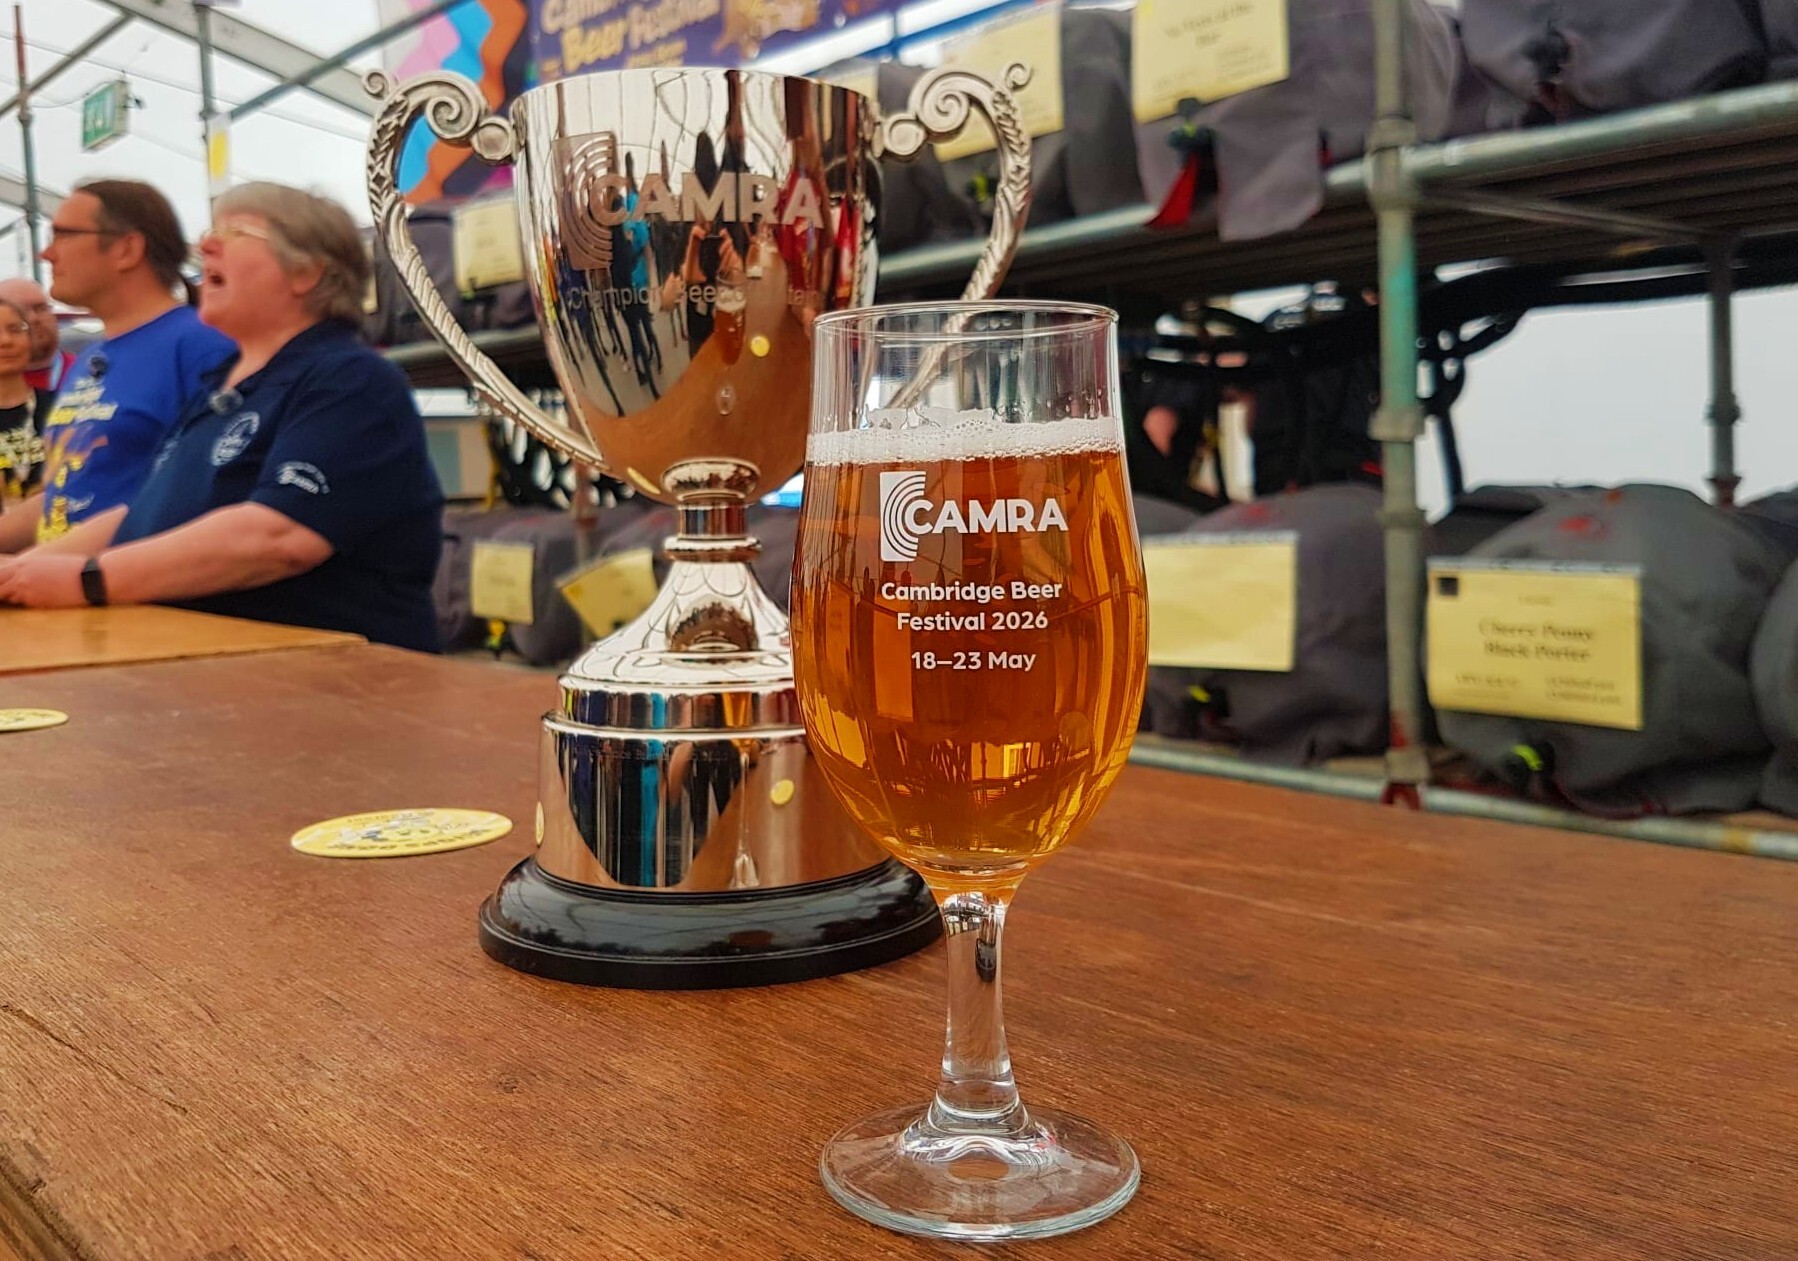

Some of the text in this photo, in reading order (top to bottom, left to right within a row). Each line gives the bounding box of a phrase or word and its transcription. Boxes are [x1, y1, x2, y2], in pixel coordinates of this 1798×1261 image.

[589, 171, 824, 229] CAMRA
[904, 498, 1069, 535] CAMRA
[881, 581, 1063, 604] Cambridge Beer
[897, 611, 1049, 631] Festival 2026
[988, 651, 1037, 672] May
